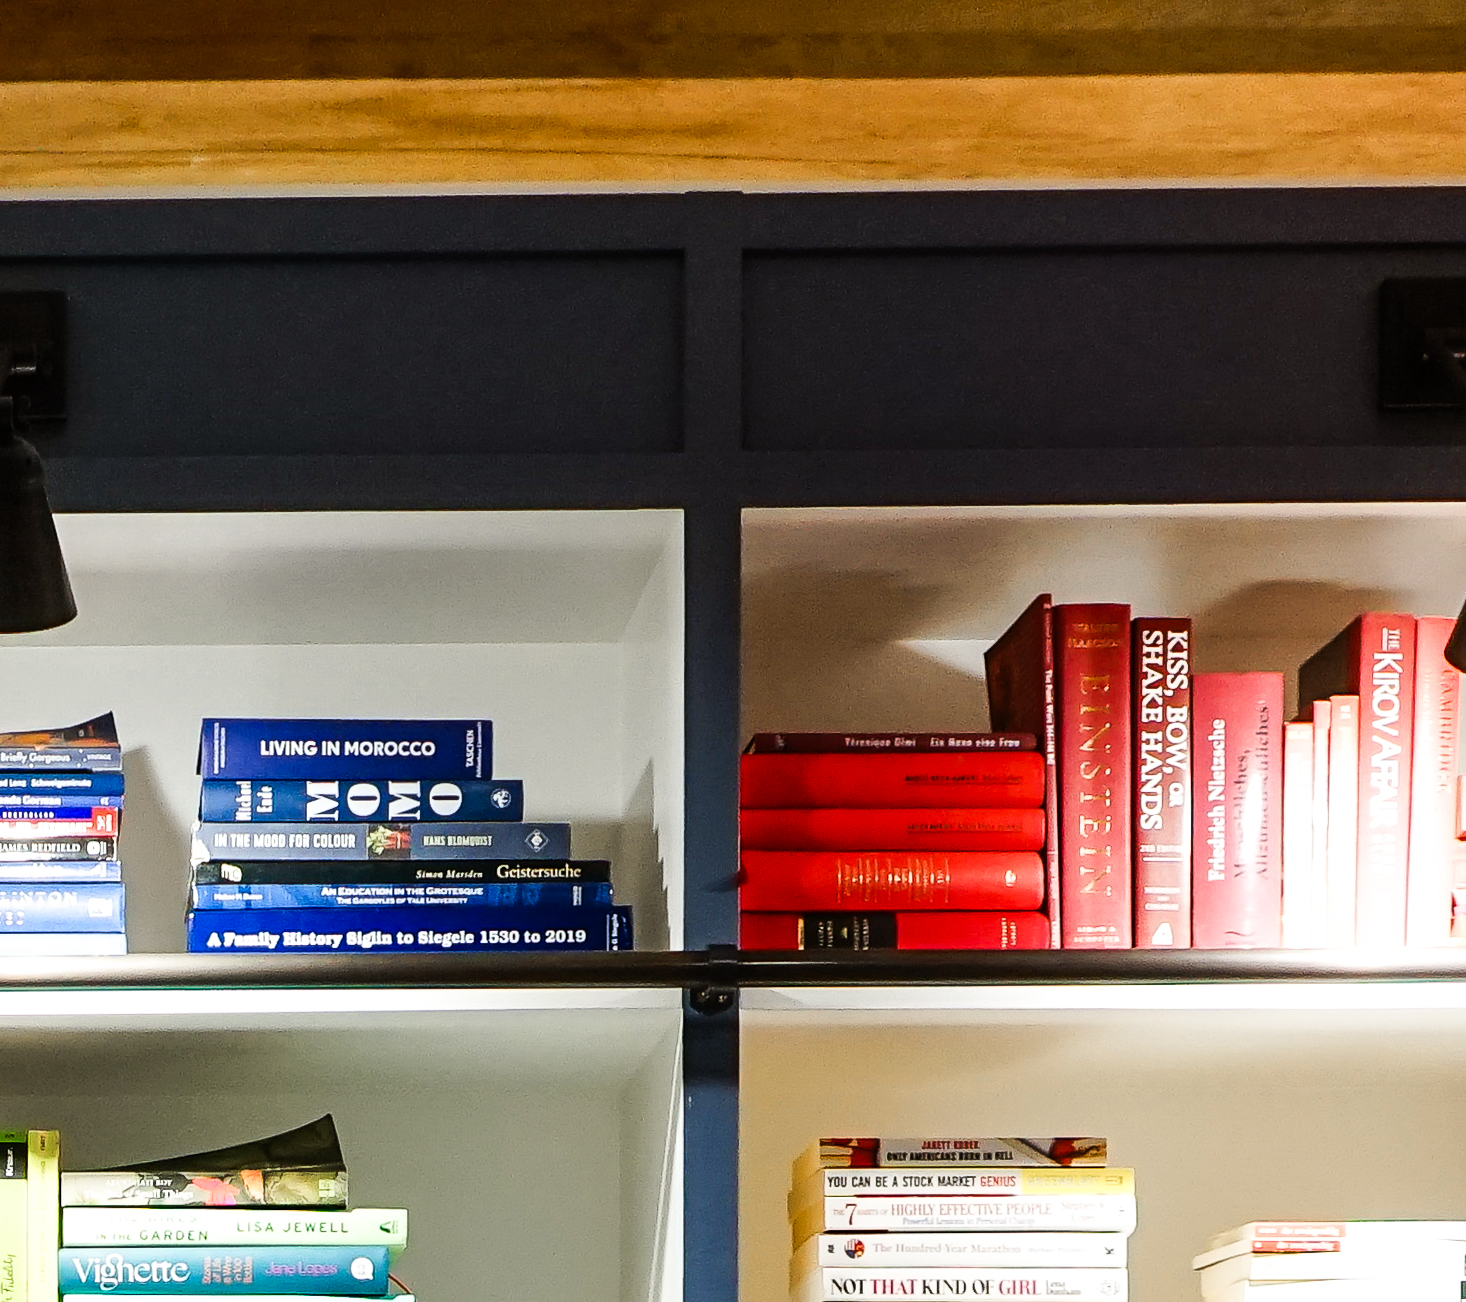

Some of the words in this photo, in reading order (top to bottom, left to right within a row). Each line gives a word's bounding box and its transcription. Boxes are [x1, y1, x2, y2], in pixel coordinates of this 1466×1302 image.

[1164, 631, 1188, 696] KISS,
[1142, 631, 1163, 723] SHAKE
[1372, 653, 1403, 736] KIROV
[1165, 706, 1188, 774] BOW,
[260, 740, 317, 757] LIVING
[321, 741, 340, 756] IN
[344, 741, 435, 756] MOROCCO
[1, 752, 27, 763] Briefly
[30, 753, 70, 764] Gorgeous
[1141, 732, 1163, 830] HANDS
[1168, 783, 1184, 807] OR
[31, 842, 80, 852] REDFIELD
[214, 834, 228, 847] IN
[232, 834, 250, 847] THE
[253, 834, 285, 847] MOOD
[289, 834, 309, 848] FOR
[312, 834, 355, 848] COLOUR
[497, 864, 581, 879] Geistersuche
[207, 932, 221, 945] A
[224, 932, 279, 949] Family
[283, 932, 342, 948] History
[346, 931, 392, 949] Siglin
[396, 933, 414, 945] to
[418, 930, 474, 948] Siegele
[479, 930, 518, 944] 1530
[523, 932, 541, 944] to
[545, 930, 586, 943] 2019
[828, 1177, 847, 1187] YOU
[851, 1176, 870, 1187] CAN
[876, 1176, 887, 1187] BE
[892, 1176, 898, 1187] A
[903, 1176, 933, 1187] STOCK
[938, 1176, 976, 1186] MARKET
[980, 1176, 1016, 1186] GENIUS
[891, 1205, 935, 1215] HIGHLY
[939, 1204, 1003, 1215] EFFECTIVE
[1007, 1203, 1052, 1215] PEOPLE
[237, 1222, 273, 1233] LISA
[284, 1222, 348, 1233] JEWELL
[831, 1279, 868, 1294] NOT
[870, 1279, 917, 1294] THAT
[922, 1279, 966, 1294] KIND
[972, 1279, 994, 1294] OF
[999, 1280, 1041, 1295] GIRL
